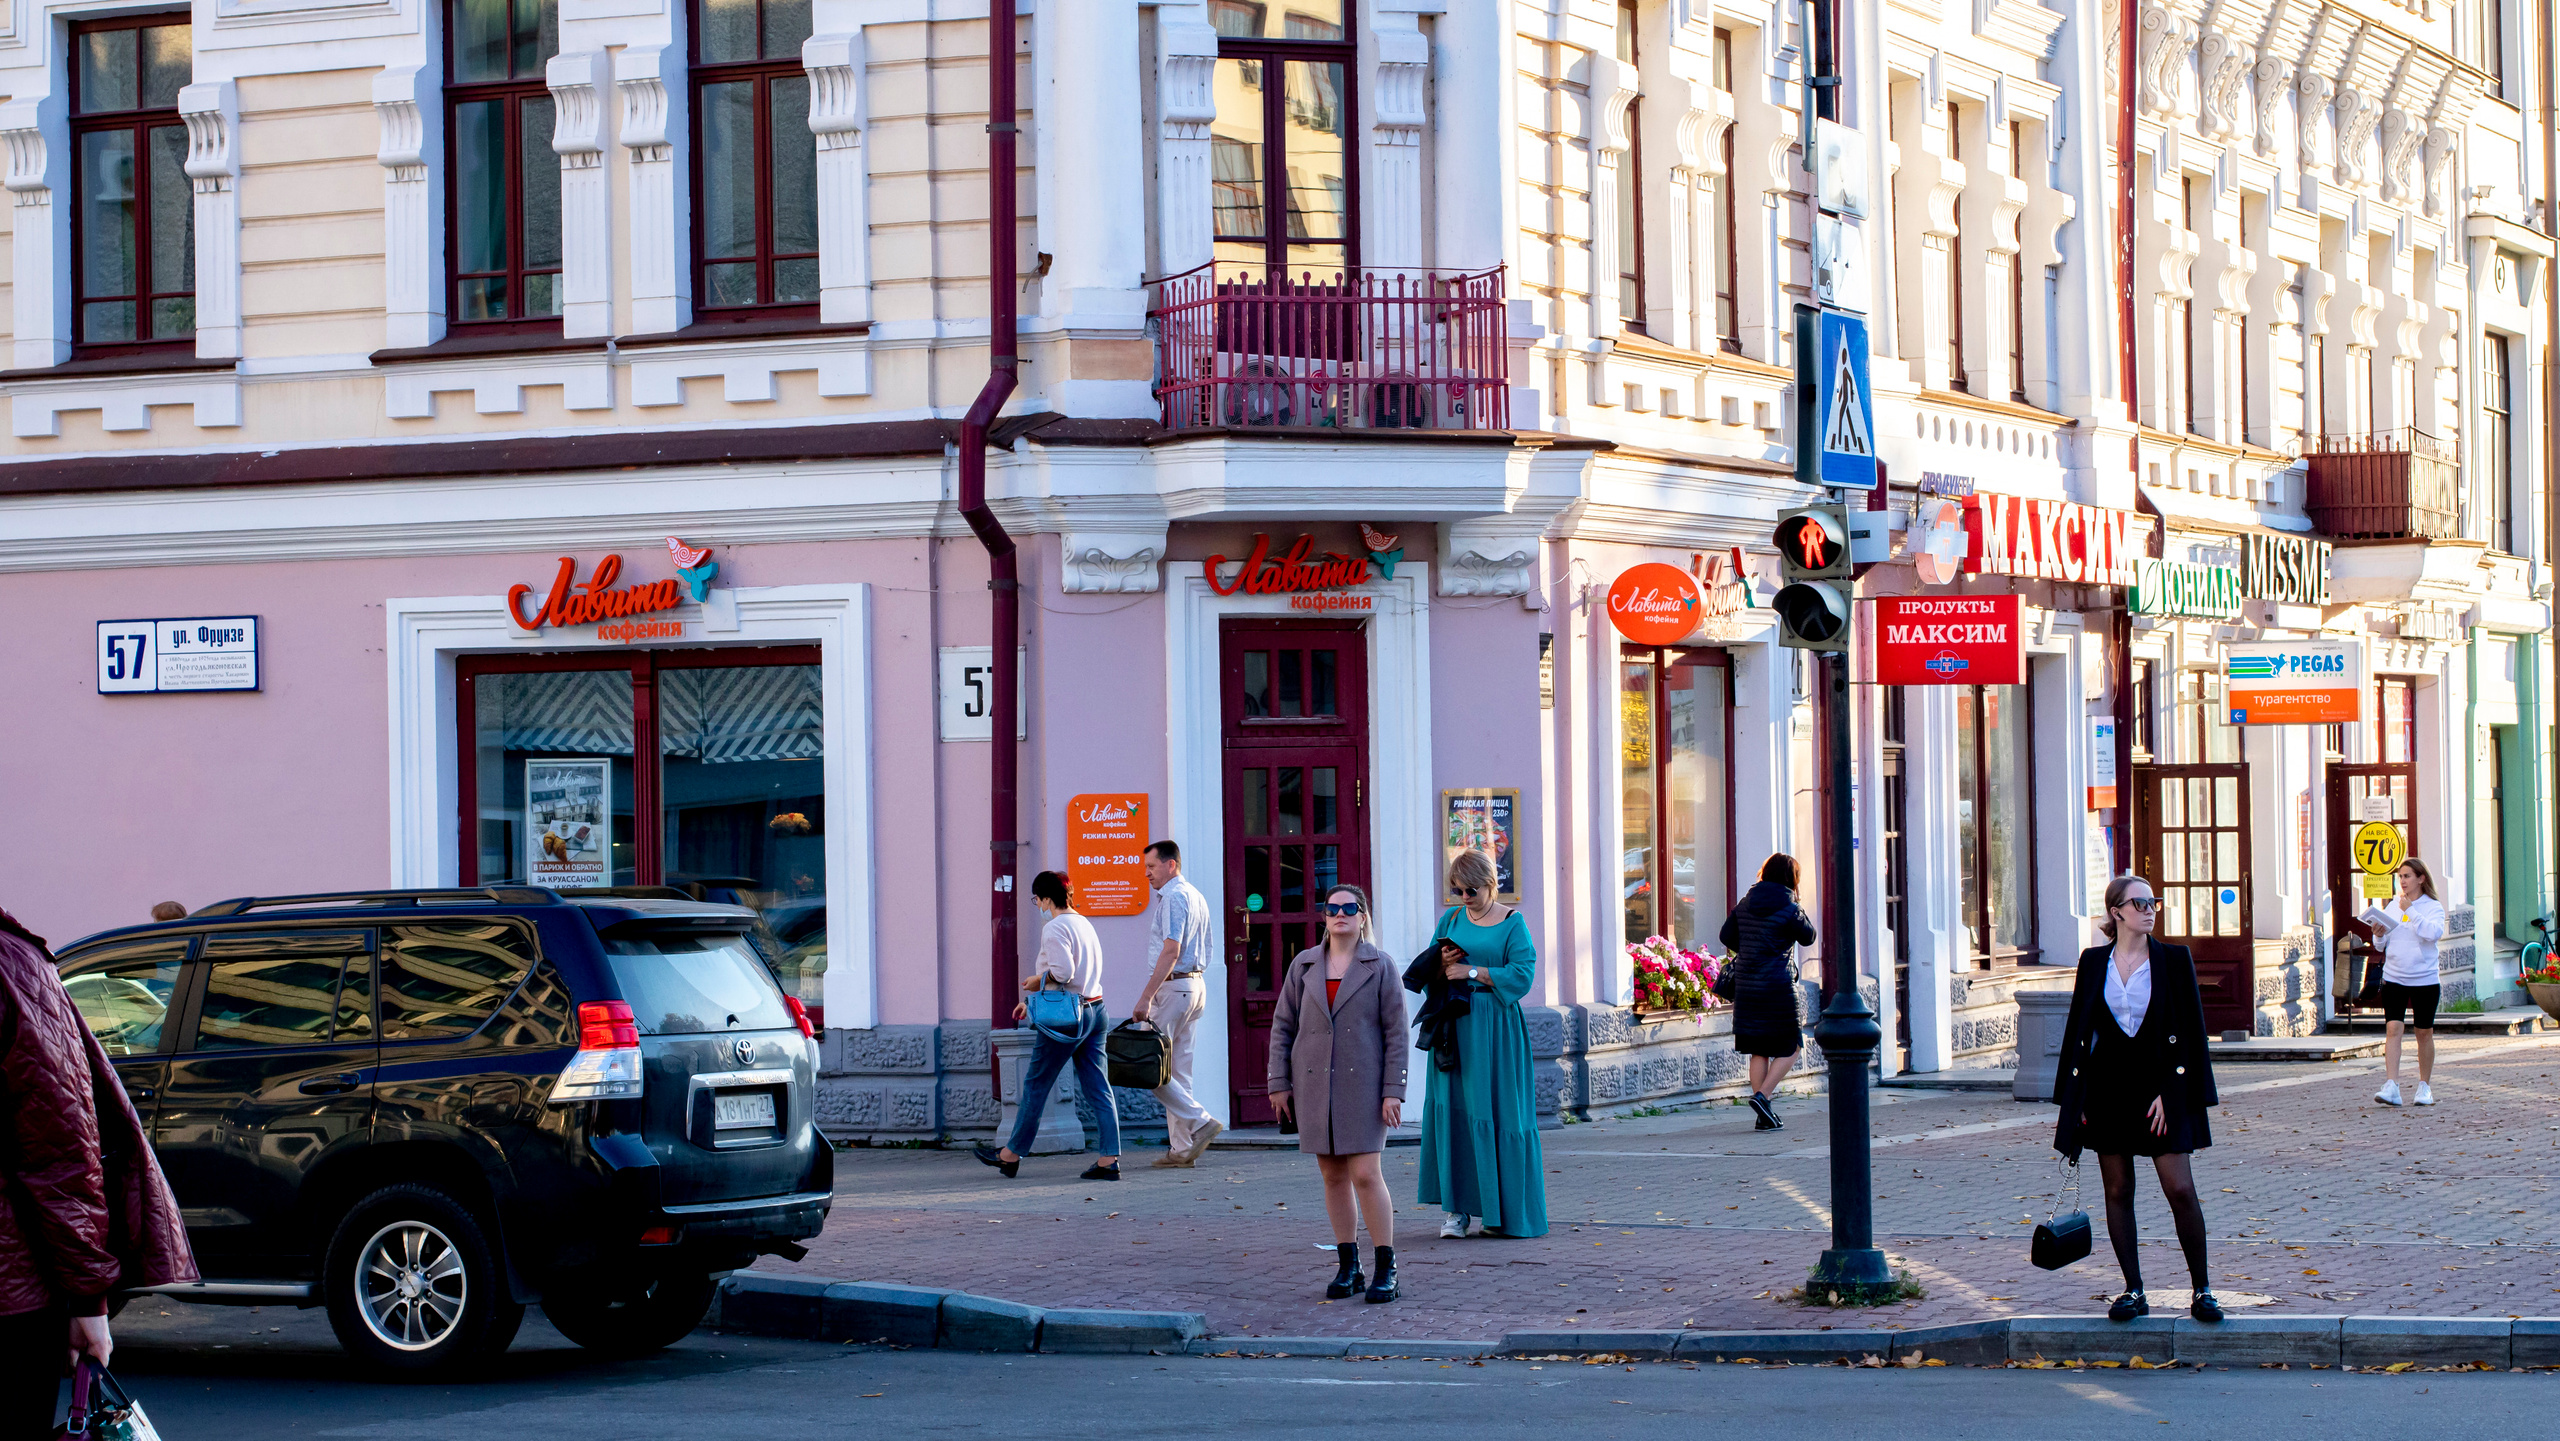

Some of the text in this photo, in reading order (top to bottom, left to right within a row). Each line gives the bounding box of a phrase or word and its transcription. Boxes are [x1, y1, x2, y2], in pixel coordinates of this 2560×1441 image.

[1921, 471, 1975, 498] ПРОДУКТЫ
[1979, 494, 2137, 586] МАКСИМ
[1204, 532, 1372, 596] Лавита
[2247, 533, 2331, 606] MISSME
[508, 554, 684, 630] Лавита
[1291, 591, 1372, 613] кофейня
[1611, 586, 1681, 613] Лавита
[1899, 601, 1995, 615] ПРОДУКТЫ
[598, 617, 682, 644] кофейня
[1644, 616, 1679, 624] кофейня
[173, 626, 244, 648] ул. Фрунзе
[1887, 624, 2007, 643] МАКСИМ
[107, 634, 147, 680] 57
[2290, 654, 2344, 672] PEGAS
[964, 666, 993, 717] 5
[2253, 694, 2331, 707] турагентство
[545, 770, 587, 788] Лавита
[1080, 803, 1128, 823] Лавита
[1453, 799, 1509, 808] РИМСКАЯ ПИЦЦА
[533, 863, 603, 871] В ПАРИЖ И ОБРАТНО
[1078, 855, 1106, 865] 08:00
[1112, 855, 1140, 865] 22:00
